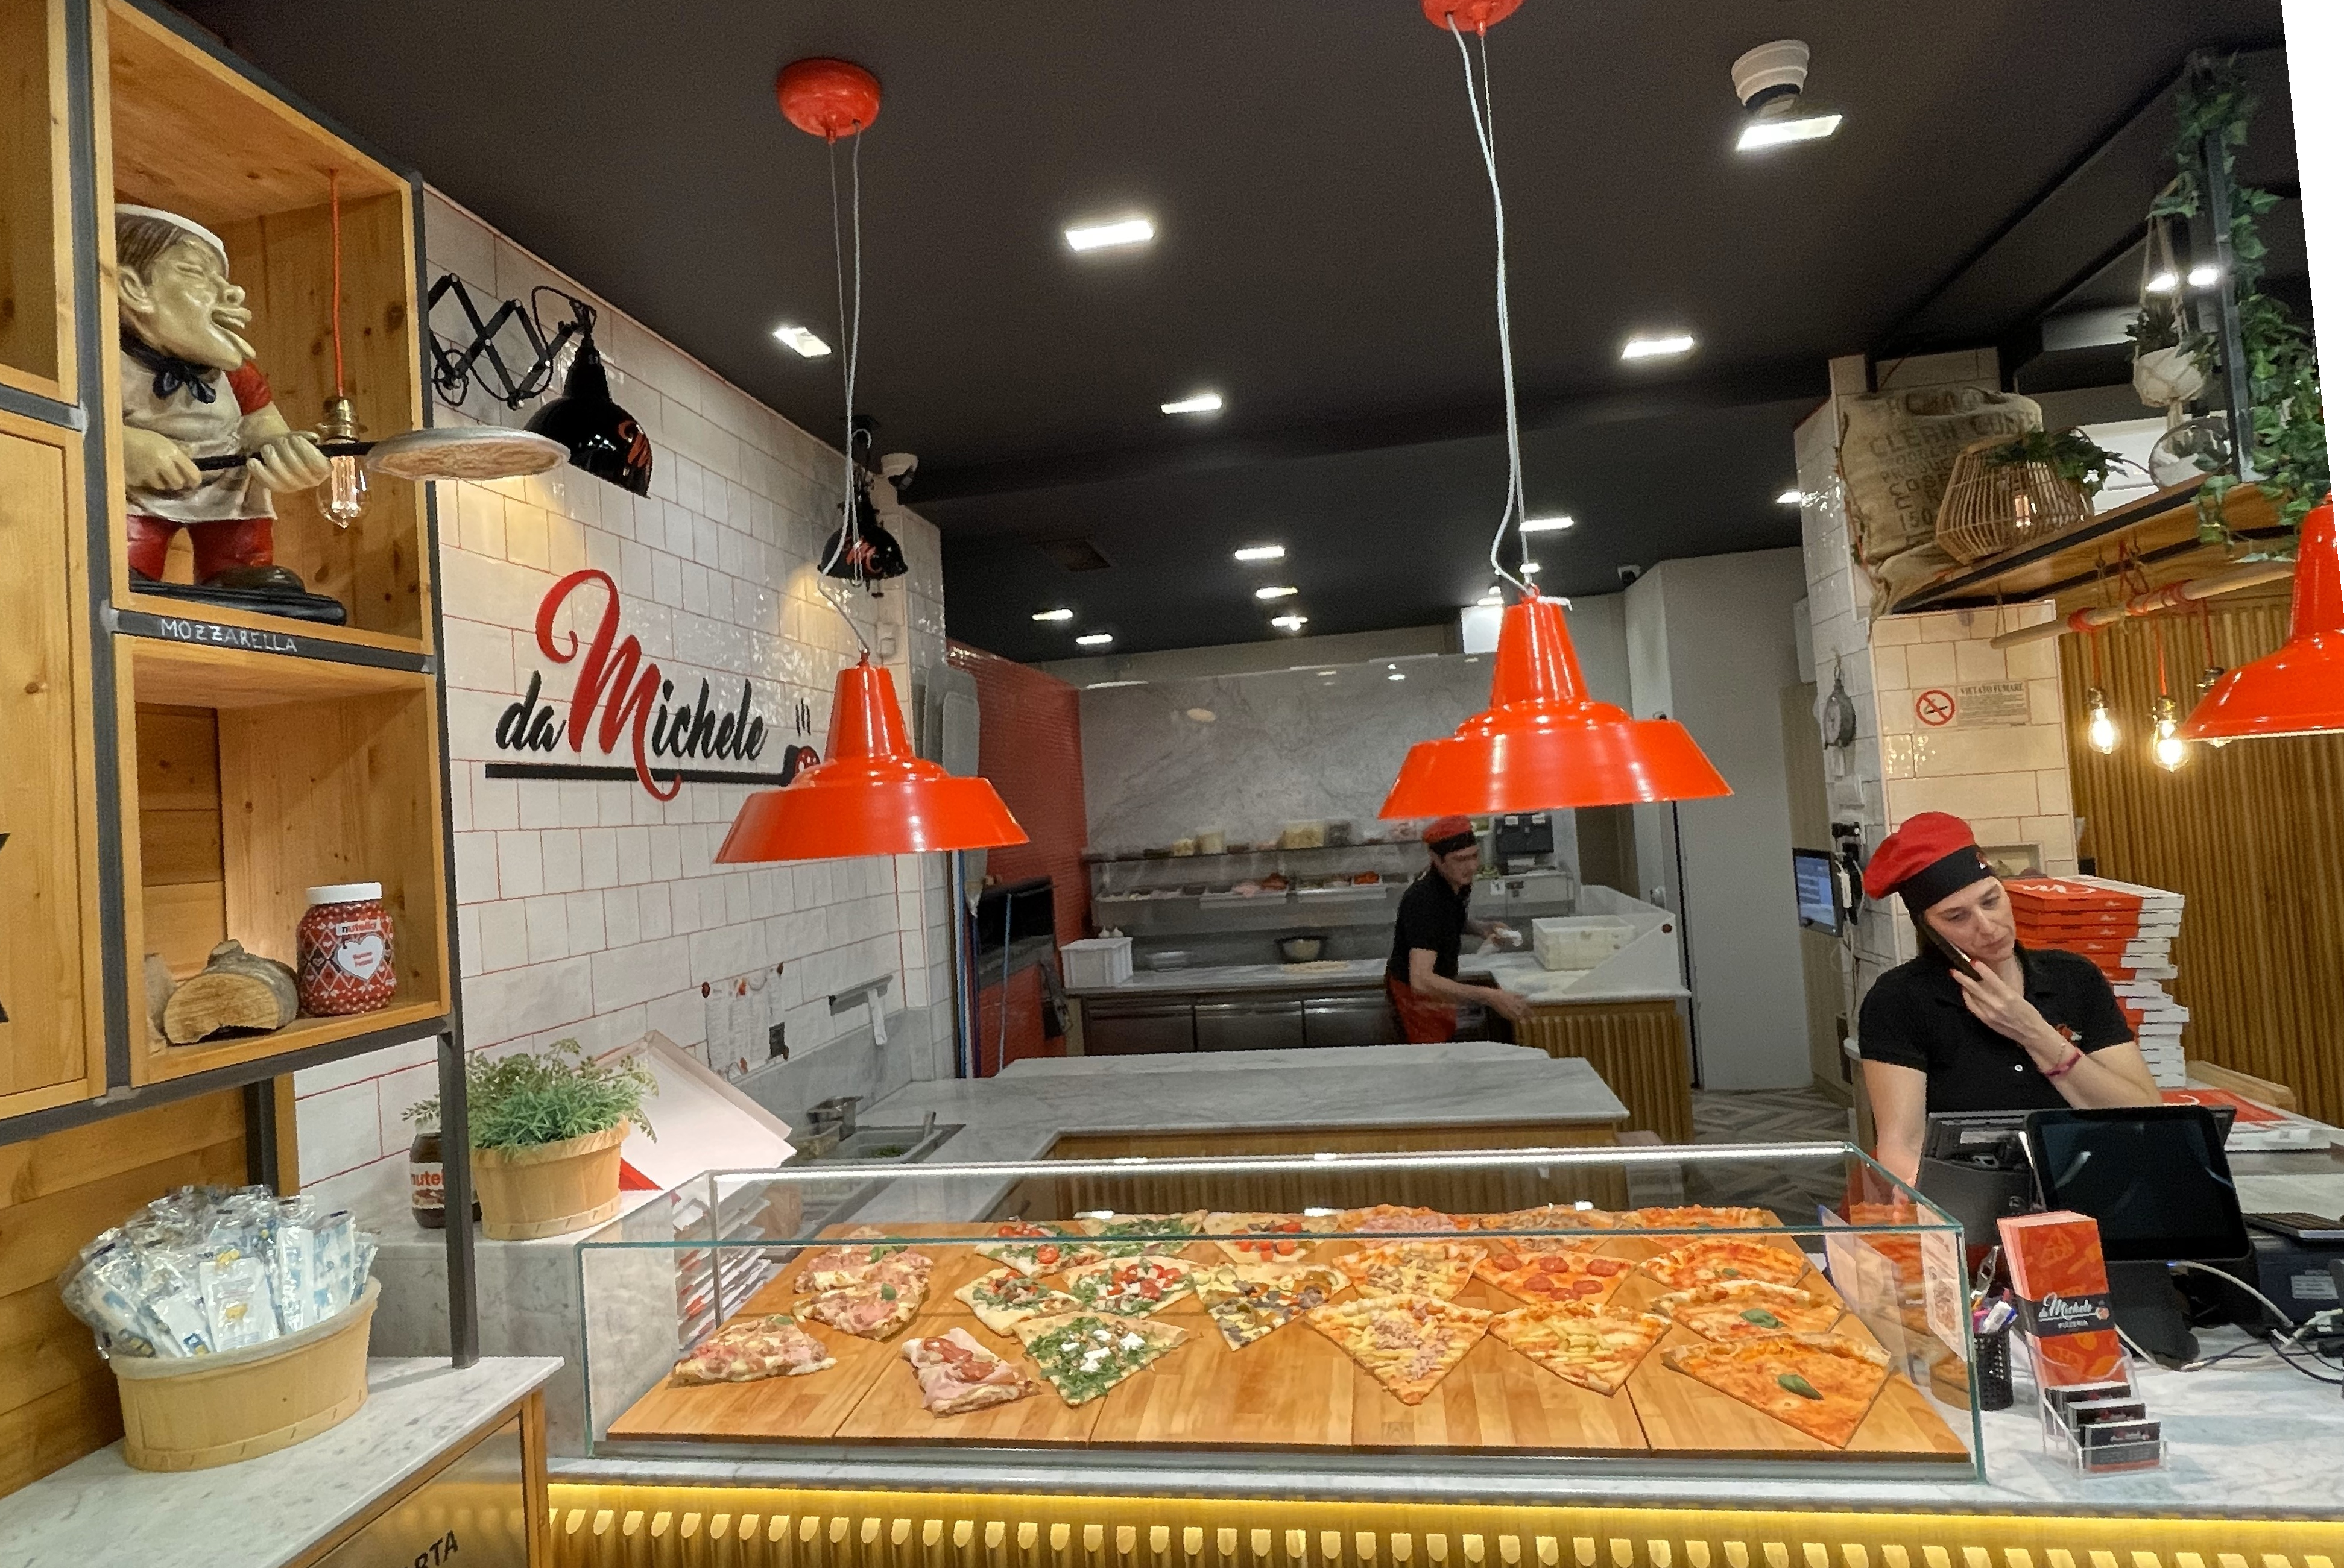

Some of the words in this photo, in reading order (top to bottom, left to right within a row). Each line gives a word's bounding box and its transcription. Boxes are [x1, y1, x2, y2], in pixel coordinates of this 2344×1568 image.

[1869, 420, 1957, 457] CLEAN
[161, 618, 298, 653] MOZZARELLA
[495, 670, 567, 752] da
[535, 569, 768, 802] Michele
[404, 1529, 458, 1568] RTA
